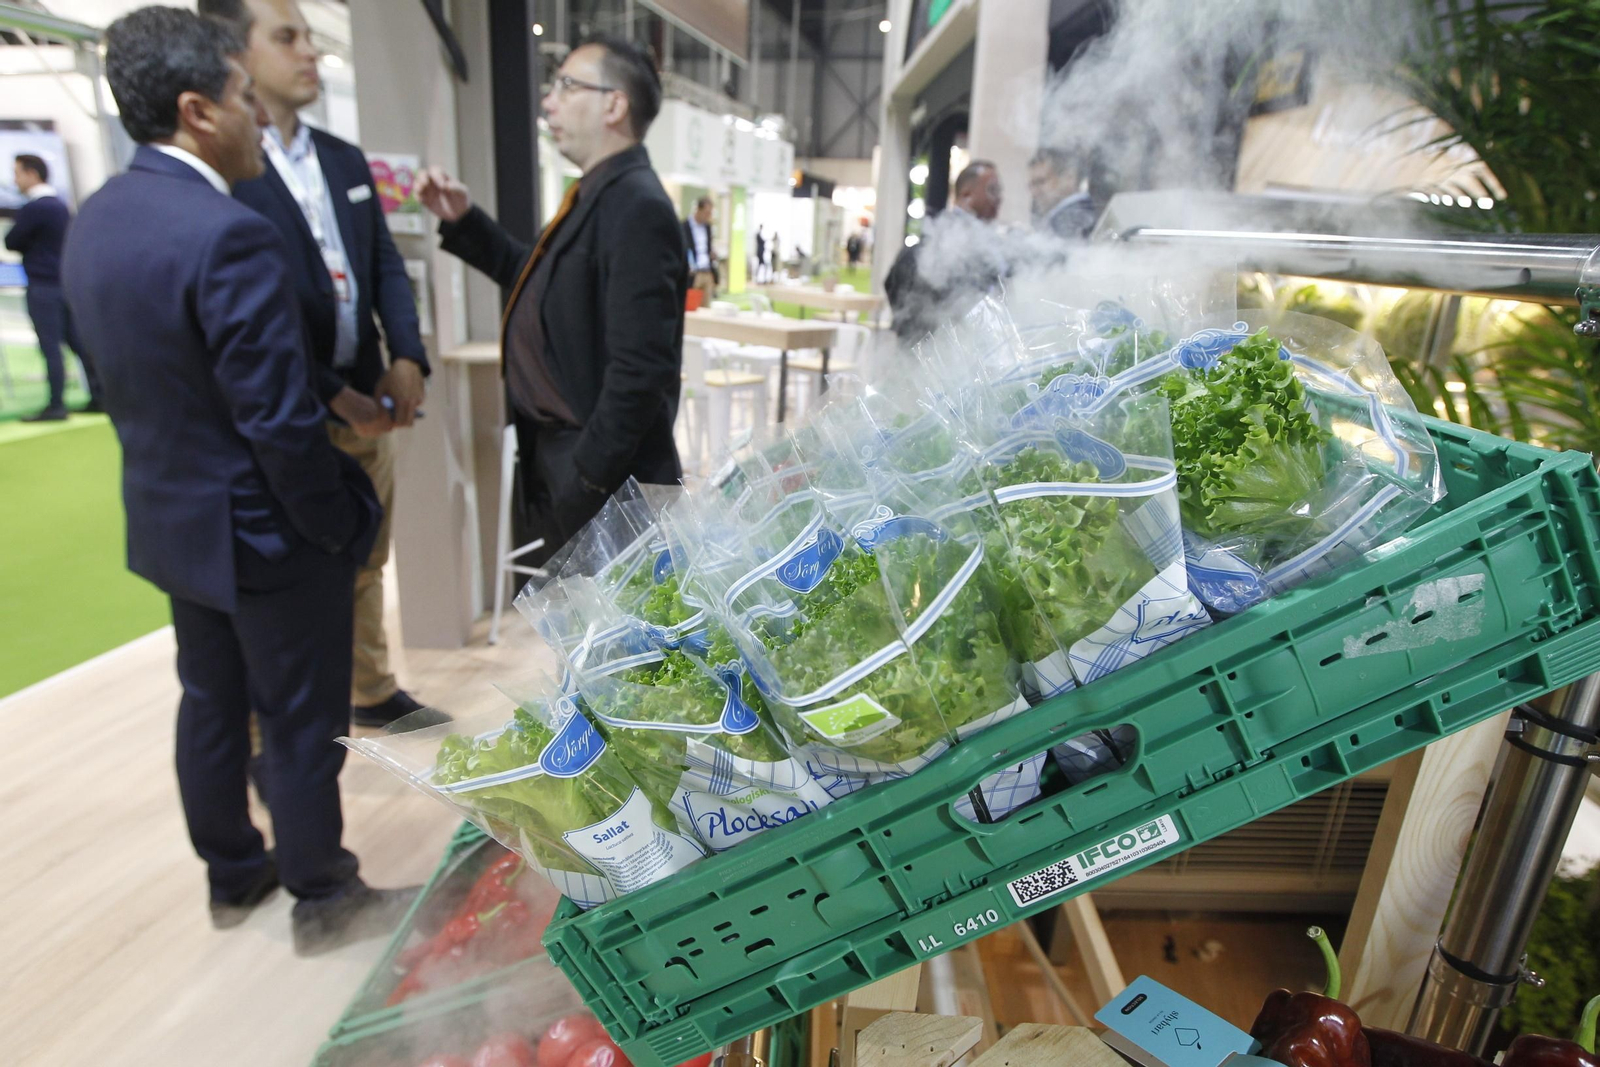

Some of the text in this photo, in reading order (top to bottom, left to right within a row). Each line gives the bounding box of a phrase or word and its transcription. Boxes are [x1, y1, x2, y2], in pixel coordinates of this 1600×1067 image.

[593, 820, 630, 844] Sallat
[1076, 833, 1137, 870] IFCO
[917, 909, 999, 954] LL 6410
